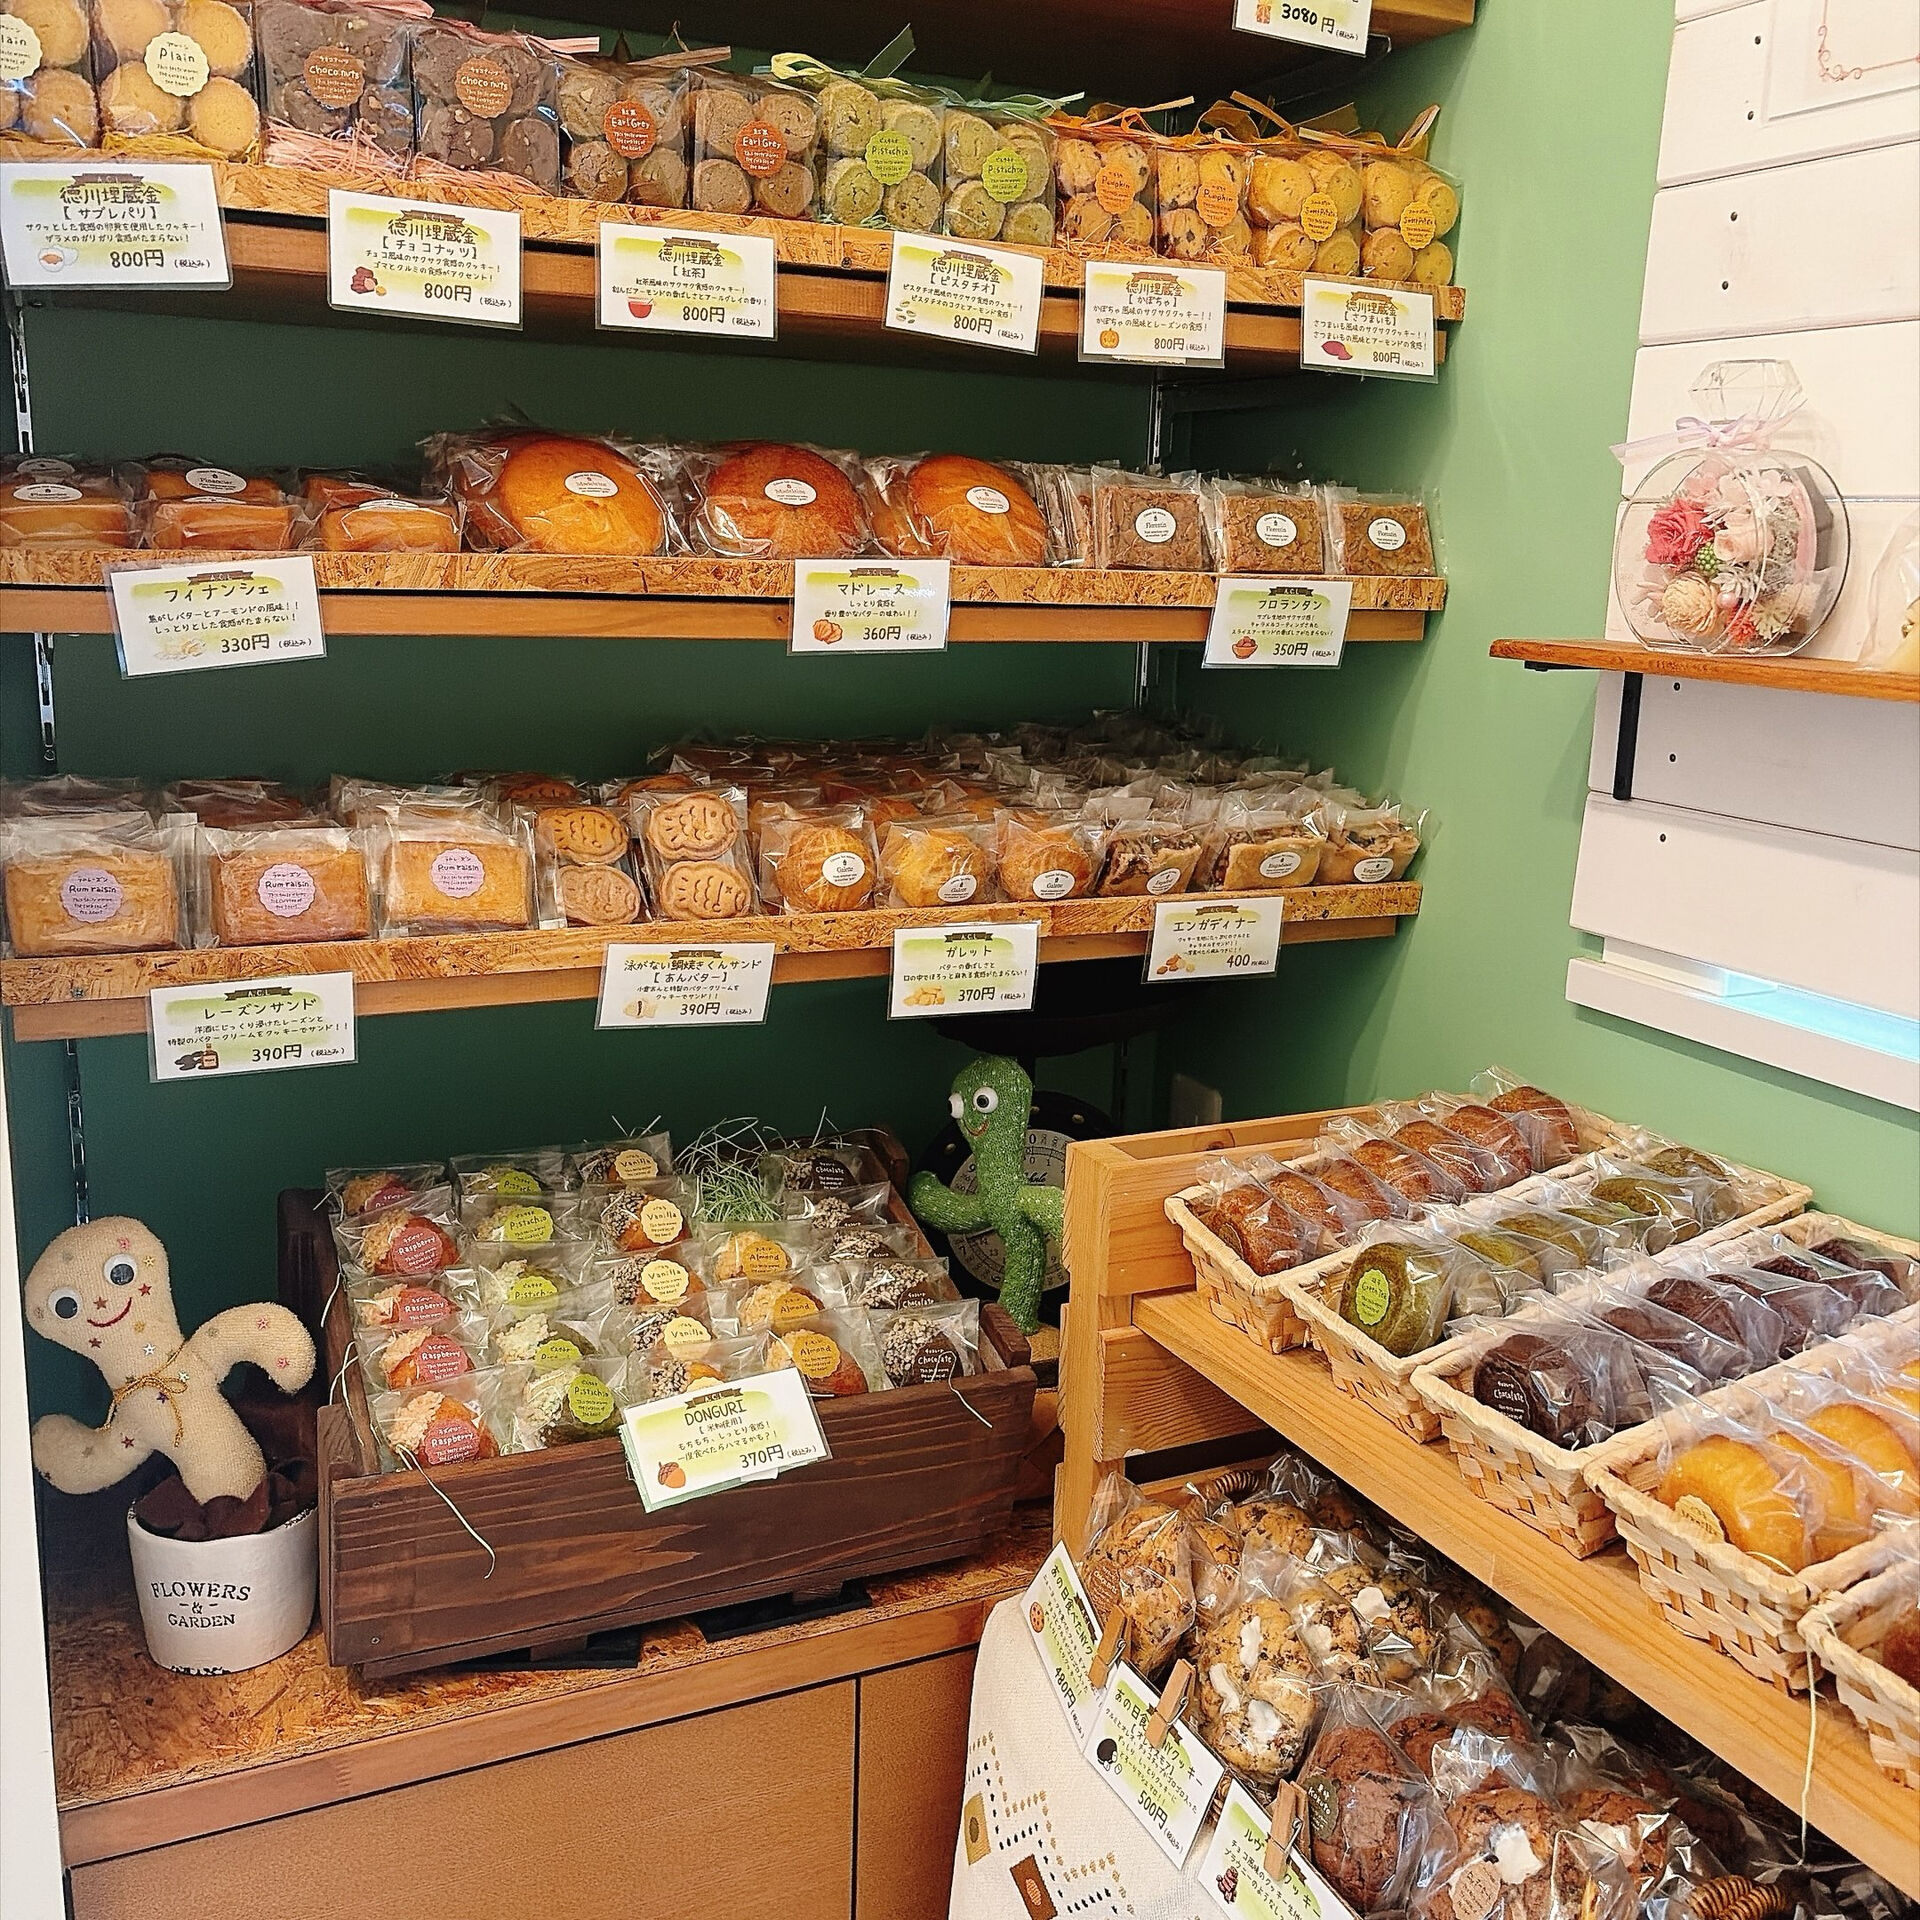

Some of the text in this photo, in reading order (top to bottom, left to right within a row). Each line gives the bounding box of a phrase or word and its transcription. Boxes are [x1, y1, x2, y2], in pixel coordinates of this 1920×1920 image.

[159, 48, 195, 63] Plain
[60, 185, 161, 205] 徳川埋蔵金
[388, 219, 478, 244] 徳川埋蔵金
[110, 250, 164, 268] 800円
[658, 248, 725, 267] 徳川埋蔵金
[672, 267, 706, 278] 【紅茶】
[931, 258, 1003, 284] 徳川埋蔵金
[425, 283, 472, 303] 800円
[1126, 281, 1184, 297] 徳川埋蔵金
[682, 306, 725, 323] 800円
[1346, 300, 1398, 317] 徳川埋蔵金
[954, 315, 992, 334] 800円
[1154, 338, 1184, 350] 800円
[1373, 351, 1400, 364] 800円
[164, 582, 270, 603] フィナンシェ
[838, 584, 905, 595] マドレーヌ
[1258, 600, 1322, 610] フロランタン
[863, 626, 901, 640] 360円
[221, 634, 270, 653] 330円
[1273, 643, 1308, 656] 350円
[69, 885, 89, 893] Rum
[1174, 918, 1256, 931] エンガディナー
[946, 945, 992, 958] ガレット
[958, 987, 995, 1001] 370円
[204, 998, 317, 1020] レーズンサンド
[680, 1002, 720, 1015] 390円
[252, 1044, 302, 1062] 390円
[509, 1215, 547, 1229] Pistachio
[647, 1212, 676, 1220] Vanilla
[398, 1236, 435, 1255] Raspberry
[648, 1269, 680, 1279] Vanilla
[405, 1302, 444, 1313] Raspberry
[670, 1328, 704, 1338] Vanilla
[421, 1350, 461, 1360] Raspberry
[801, 1345, 831, 1355] Almond
[575, 1387, 608, 1397] Pistachio
[684, 1400, 747, 1426] DONGURI
[432, 1433, 473, 1447] Raspberry
[740, 1444, 784, 1469] 370円
[151, 1582, 251, 1601] FLOWERS
[192, 1602, 203, 1614] &
[168, 1614, 235, 1627] GARDEN
[1054, 1667, 1076, 1708] 480円
[1137, 1790, 1168, 1829] 500円
